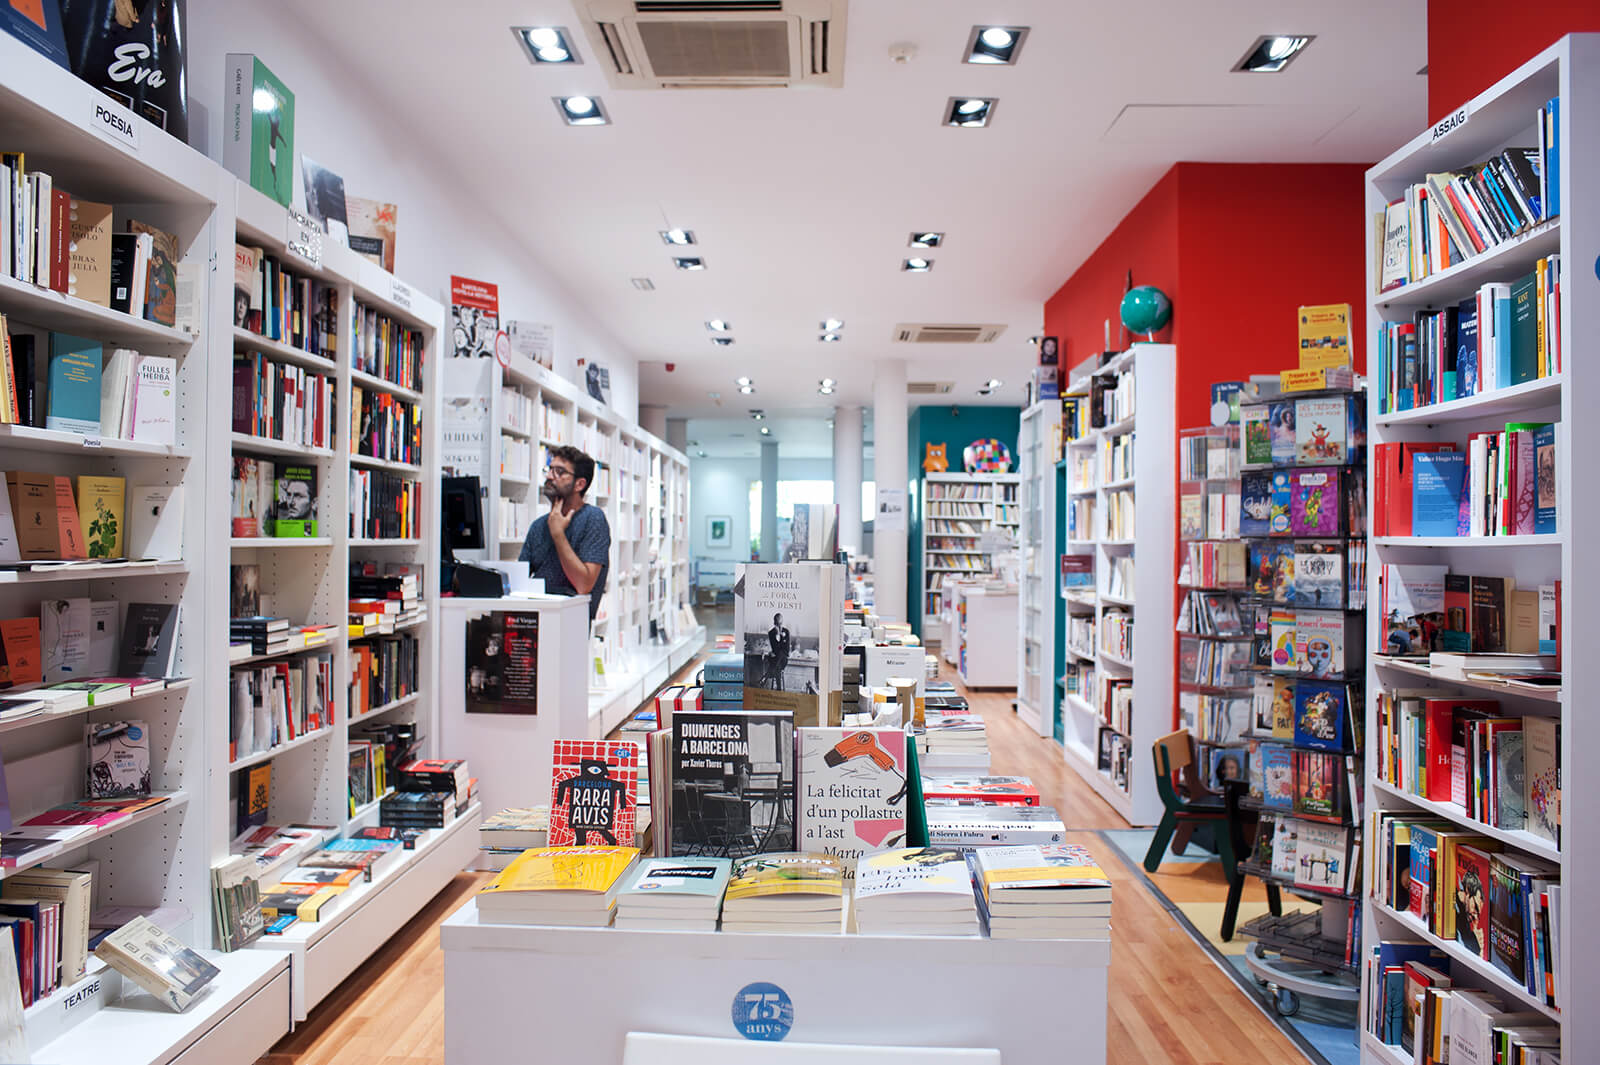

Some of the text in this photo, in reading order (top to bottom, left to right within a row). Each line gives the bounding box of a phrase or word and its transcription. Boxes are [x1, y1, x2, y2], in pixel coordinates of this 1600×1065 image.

[108, 43, 166, 88] Eva
[95, 105, 133, 137] POESIA
[1432, 110, 1465, 141] ASSAIG
[142, 365, 170, 375] FULLES
[759, 581, 800, 590] GIRONELL
[681, 723, 741, 739] DIUMENGES
[681, 741, 748, 756] A BARCELONA
[573, 788, 610, 806] RARA
[807, 784, 881, 798] La felicitat
[572, 807, 609, 825] AVIS
[807, 804, 903, 822] d'un pollastre
[807, 824, 845, 839] a l'ast
[823, 845, 865, 859] Marta
[1411, 841, 1430, 857] PALAB
[1411, 859, 1430, 885] VID
[64, 980, 100, 1010] TEATRE
[745, 993, 781, 1020] 75
[746, 1023, 782, 1038] anys
